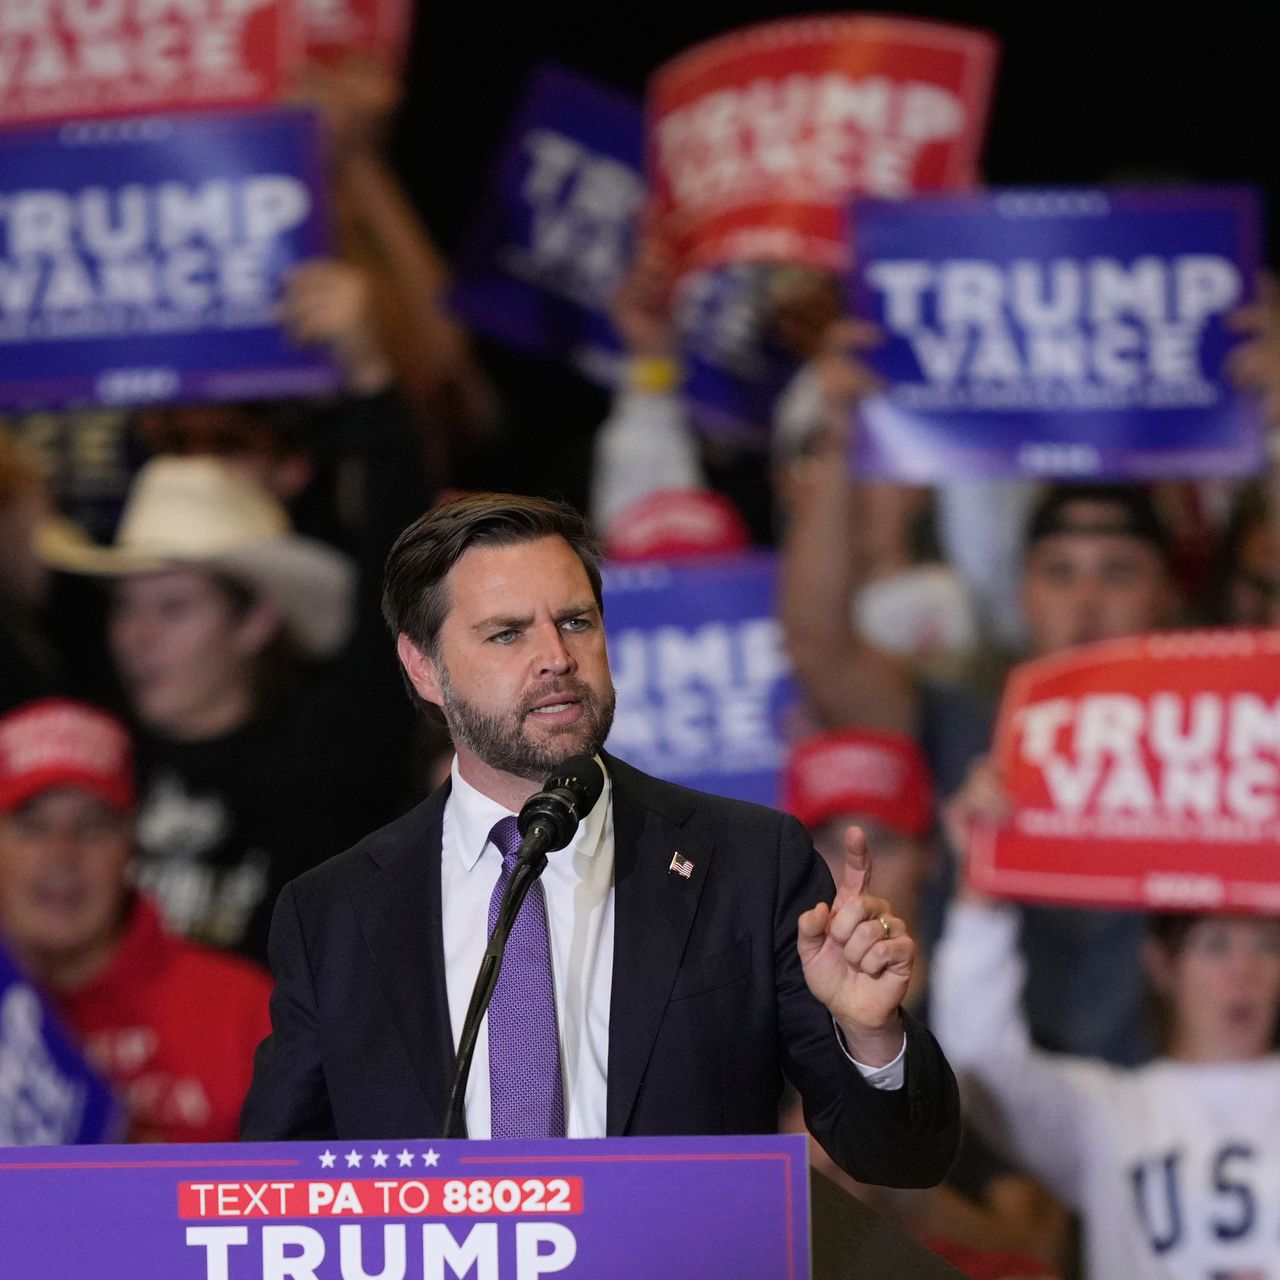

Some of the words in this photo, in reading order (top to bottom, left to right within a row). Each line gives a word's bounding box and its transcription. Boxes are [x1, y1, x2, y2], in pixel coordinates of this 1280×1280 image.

[866, 253, 1241, 334] TRUMP
[910, 318, 1200, 384] VANCE
[190, 1182, 295, 1216] TEXT
[308, 1182, 363, 1215] PA
[374, 1181, 430, 1214] TO
[442, 1179, 571, 1213] 88022
